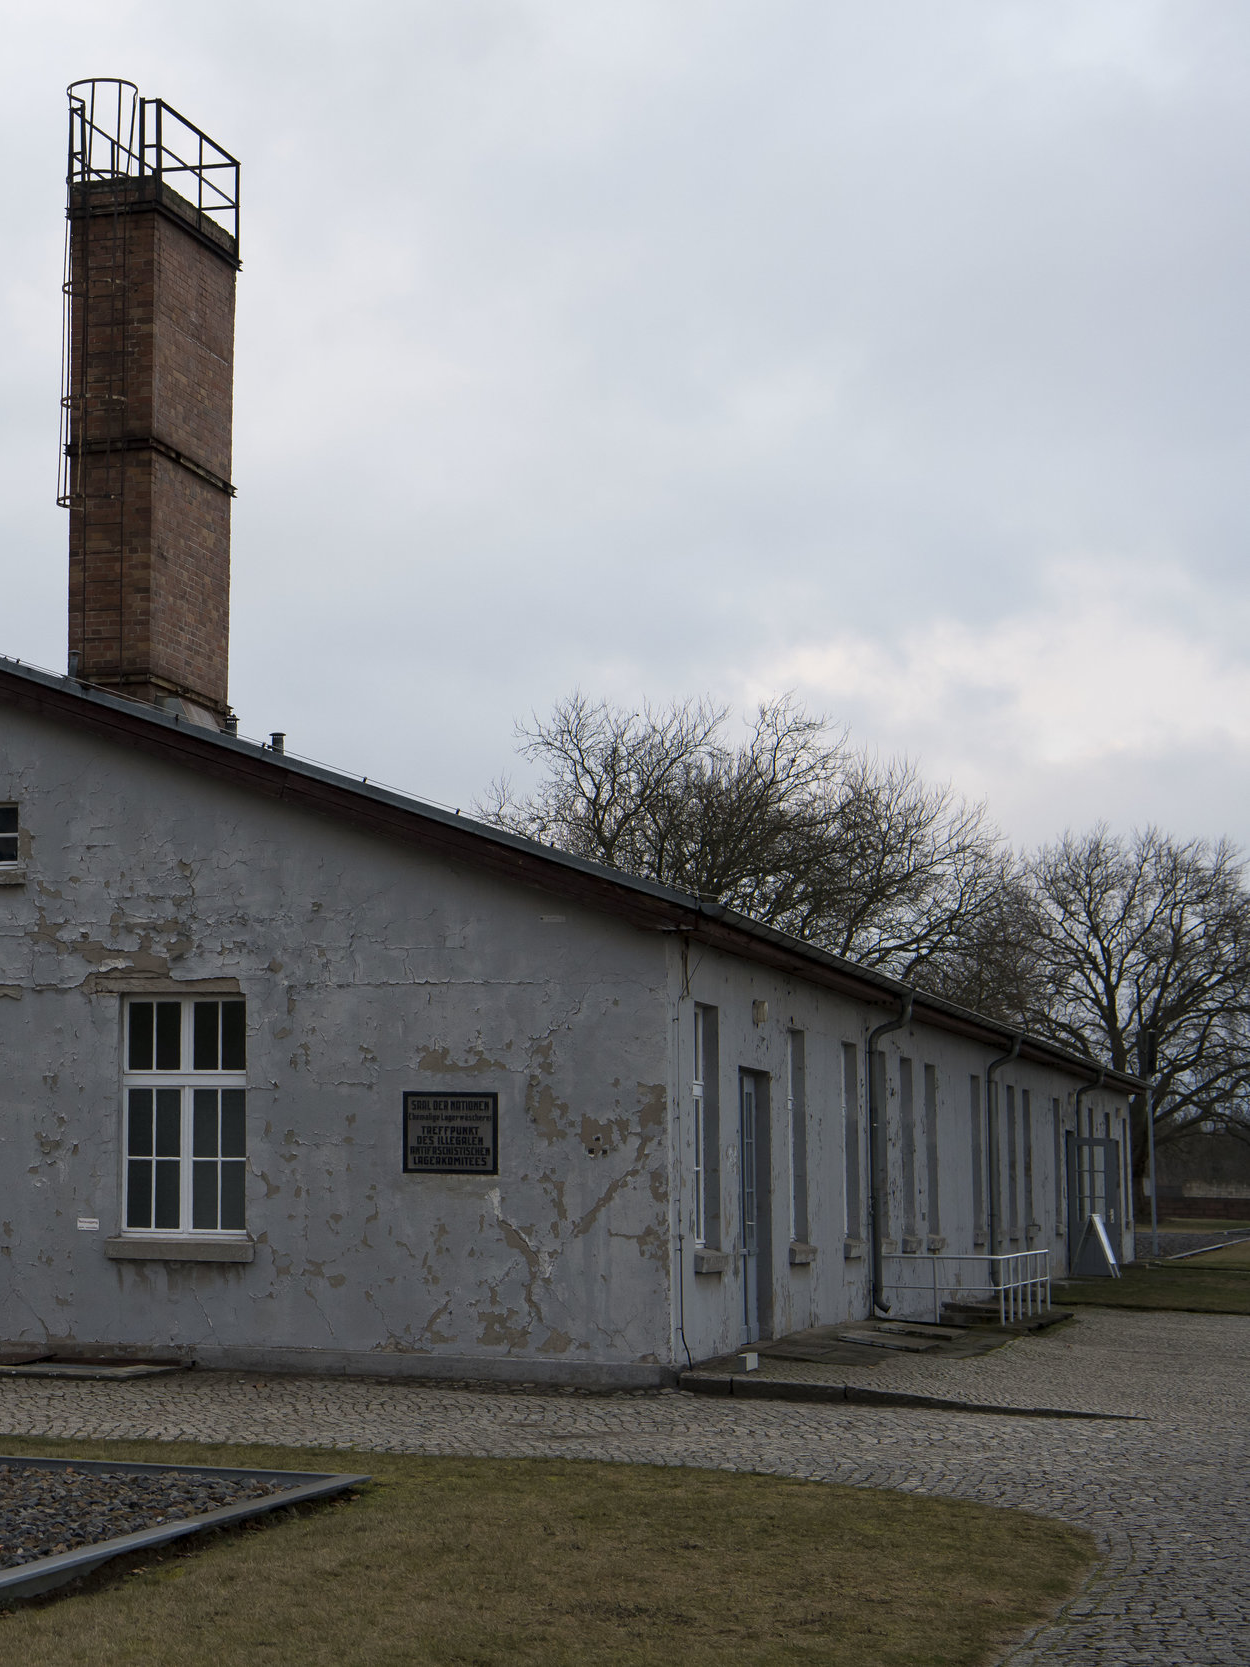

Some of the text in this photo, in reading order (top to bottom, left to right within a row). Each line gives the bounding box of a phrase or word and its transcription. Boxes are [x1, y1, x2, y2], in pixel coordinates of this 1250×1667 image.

[411, 1100, 490, 1111] SAAL DER NATIONEN
[421, 1125, 479, 1135] TREFFPUNKT
[416, 1135, 483, 1146] DES ILLEGALEN
[410, 1145, 490, 1156] ANTIFASCHISTISCHEN
[413, 1156, 487, 1166] LAGERKOMITEES
